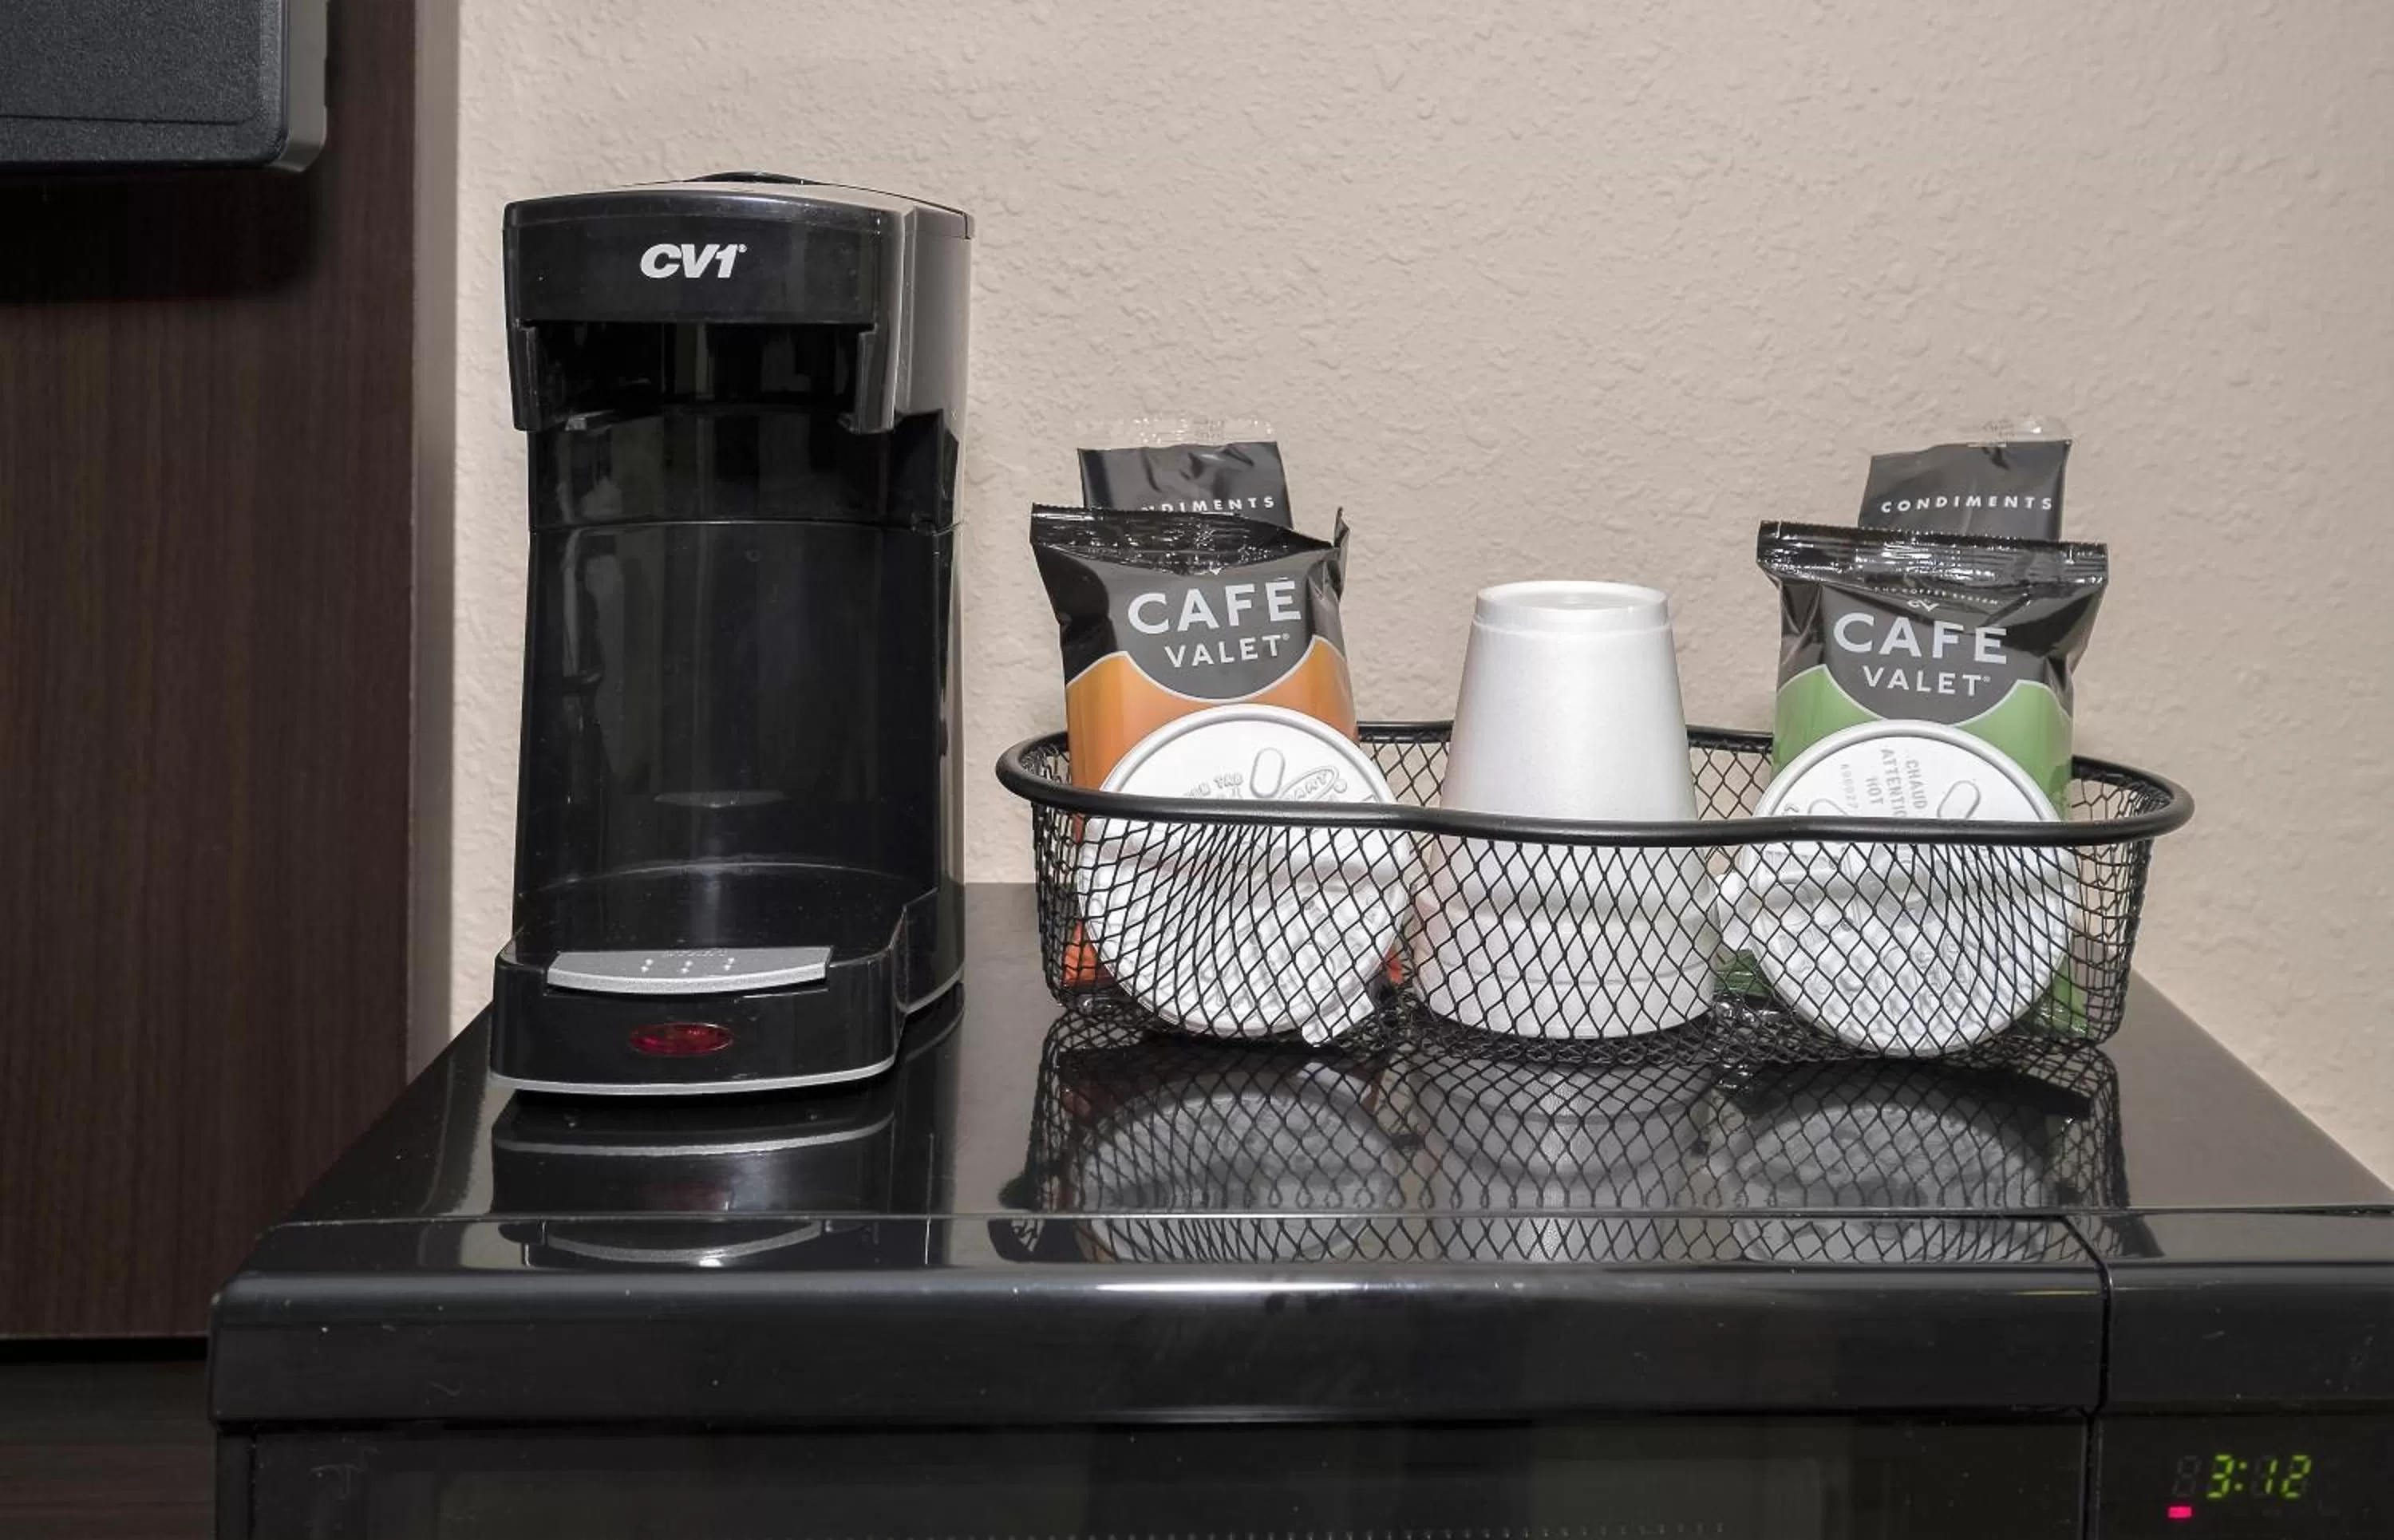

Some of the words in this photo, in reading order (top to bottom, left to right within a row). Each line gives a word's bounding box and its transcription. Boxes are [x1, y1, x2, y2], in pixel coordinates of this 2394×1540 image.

[1880, 495, 2052, 513] CONDIMENTS
[1881, 748, 1907, 817] ATTENTIO
[2207, 1454, 2312, 1499] 3:12
